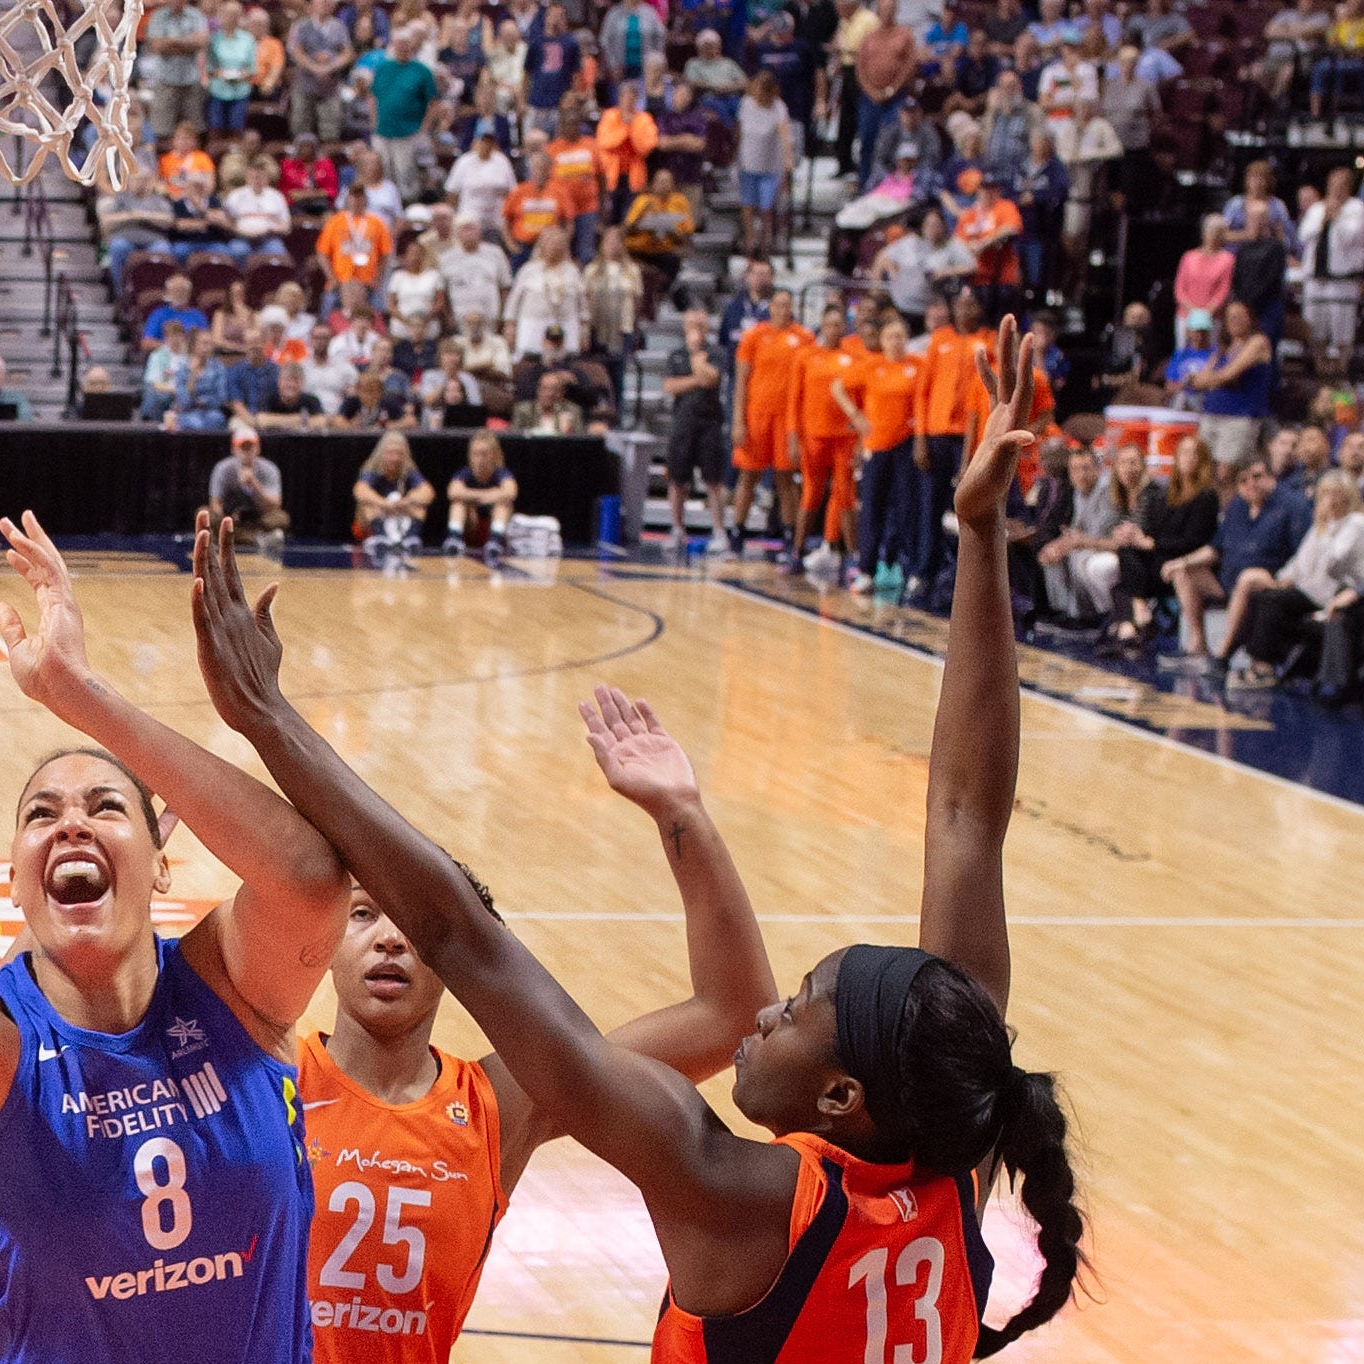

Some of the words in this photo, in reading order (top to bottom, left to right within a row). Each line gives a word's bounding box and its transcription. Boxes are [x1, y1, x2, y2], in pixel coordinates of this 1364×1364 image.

[61, 1078, 181, 1115] AMERICAN
[87, 1102, 188, 1139] FIDELITY
[336, 1148, 428, 1177] Mohegan
[431, 1160, 469, 1182] Sun
[133, 1136, 193, 1250] 8
[319, 1181, 432, 1294] 25
[85, 1250, 244, 1300] verizon
[310, 1297, 429, 1336] erizon
